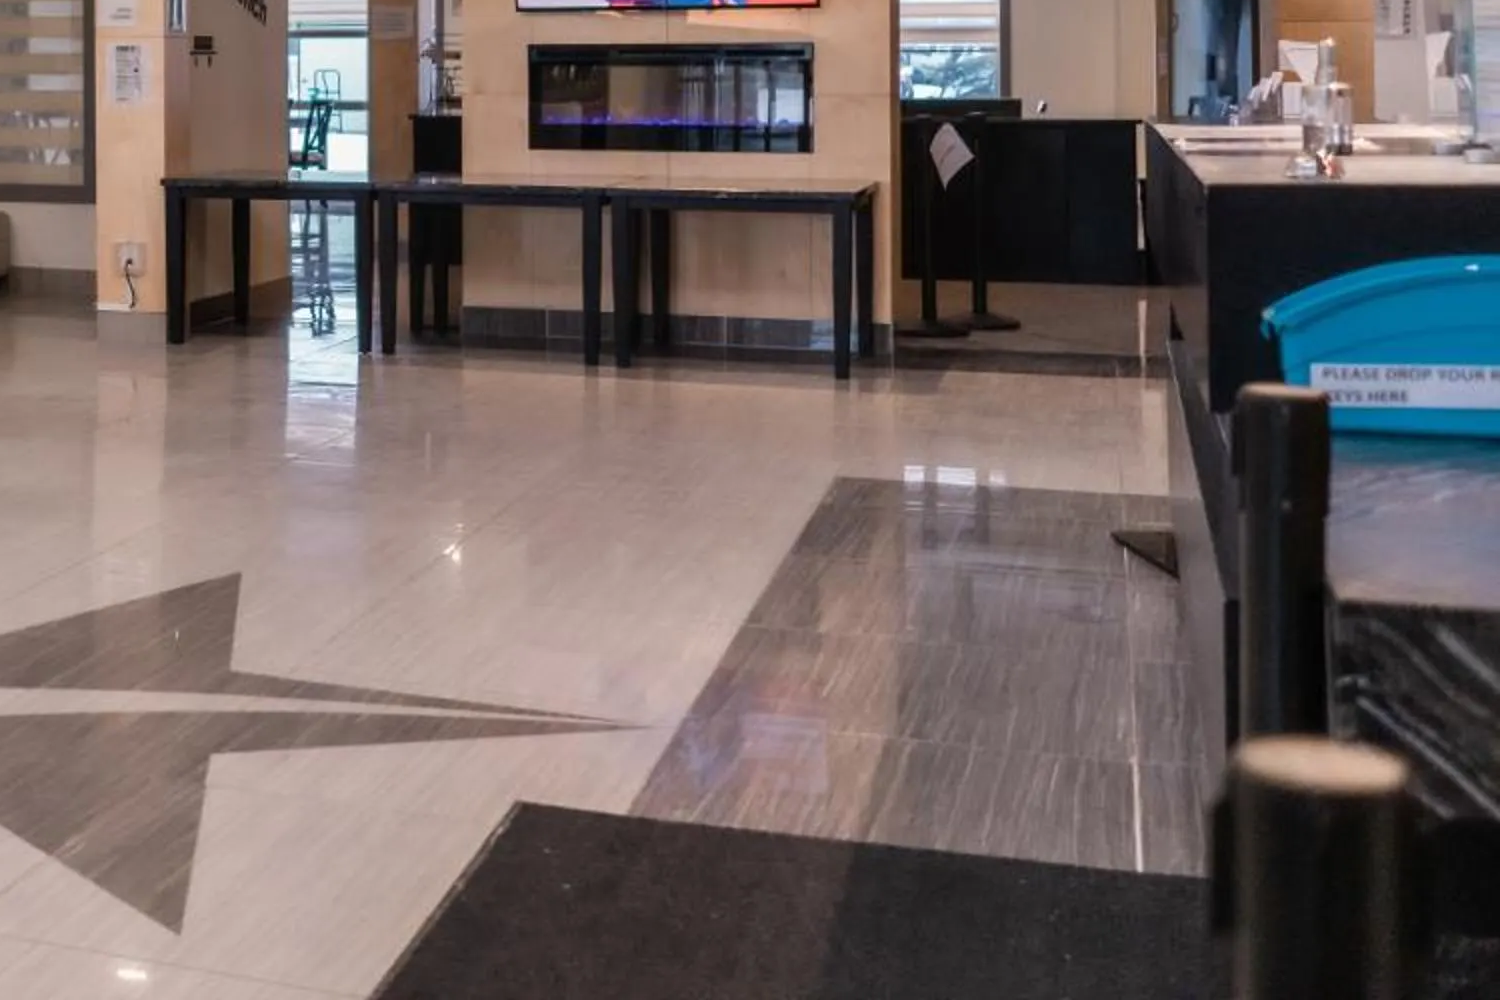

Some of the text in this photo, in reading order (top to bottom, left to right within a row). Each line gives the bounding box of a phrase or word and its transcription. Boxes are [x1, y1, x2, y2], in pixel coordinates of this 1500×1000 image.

[1323, 367, 1379, 380] PLEASE
[1385, 368, 1432, 381] DROP
[1437, 368, 1486, 381] YOUR
[1367, 390, 1409, 402] HERE
